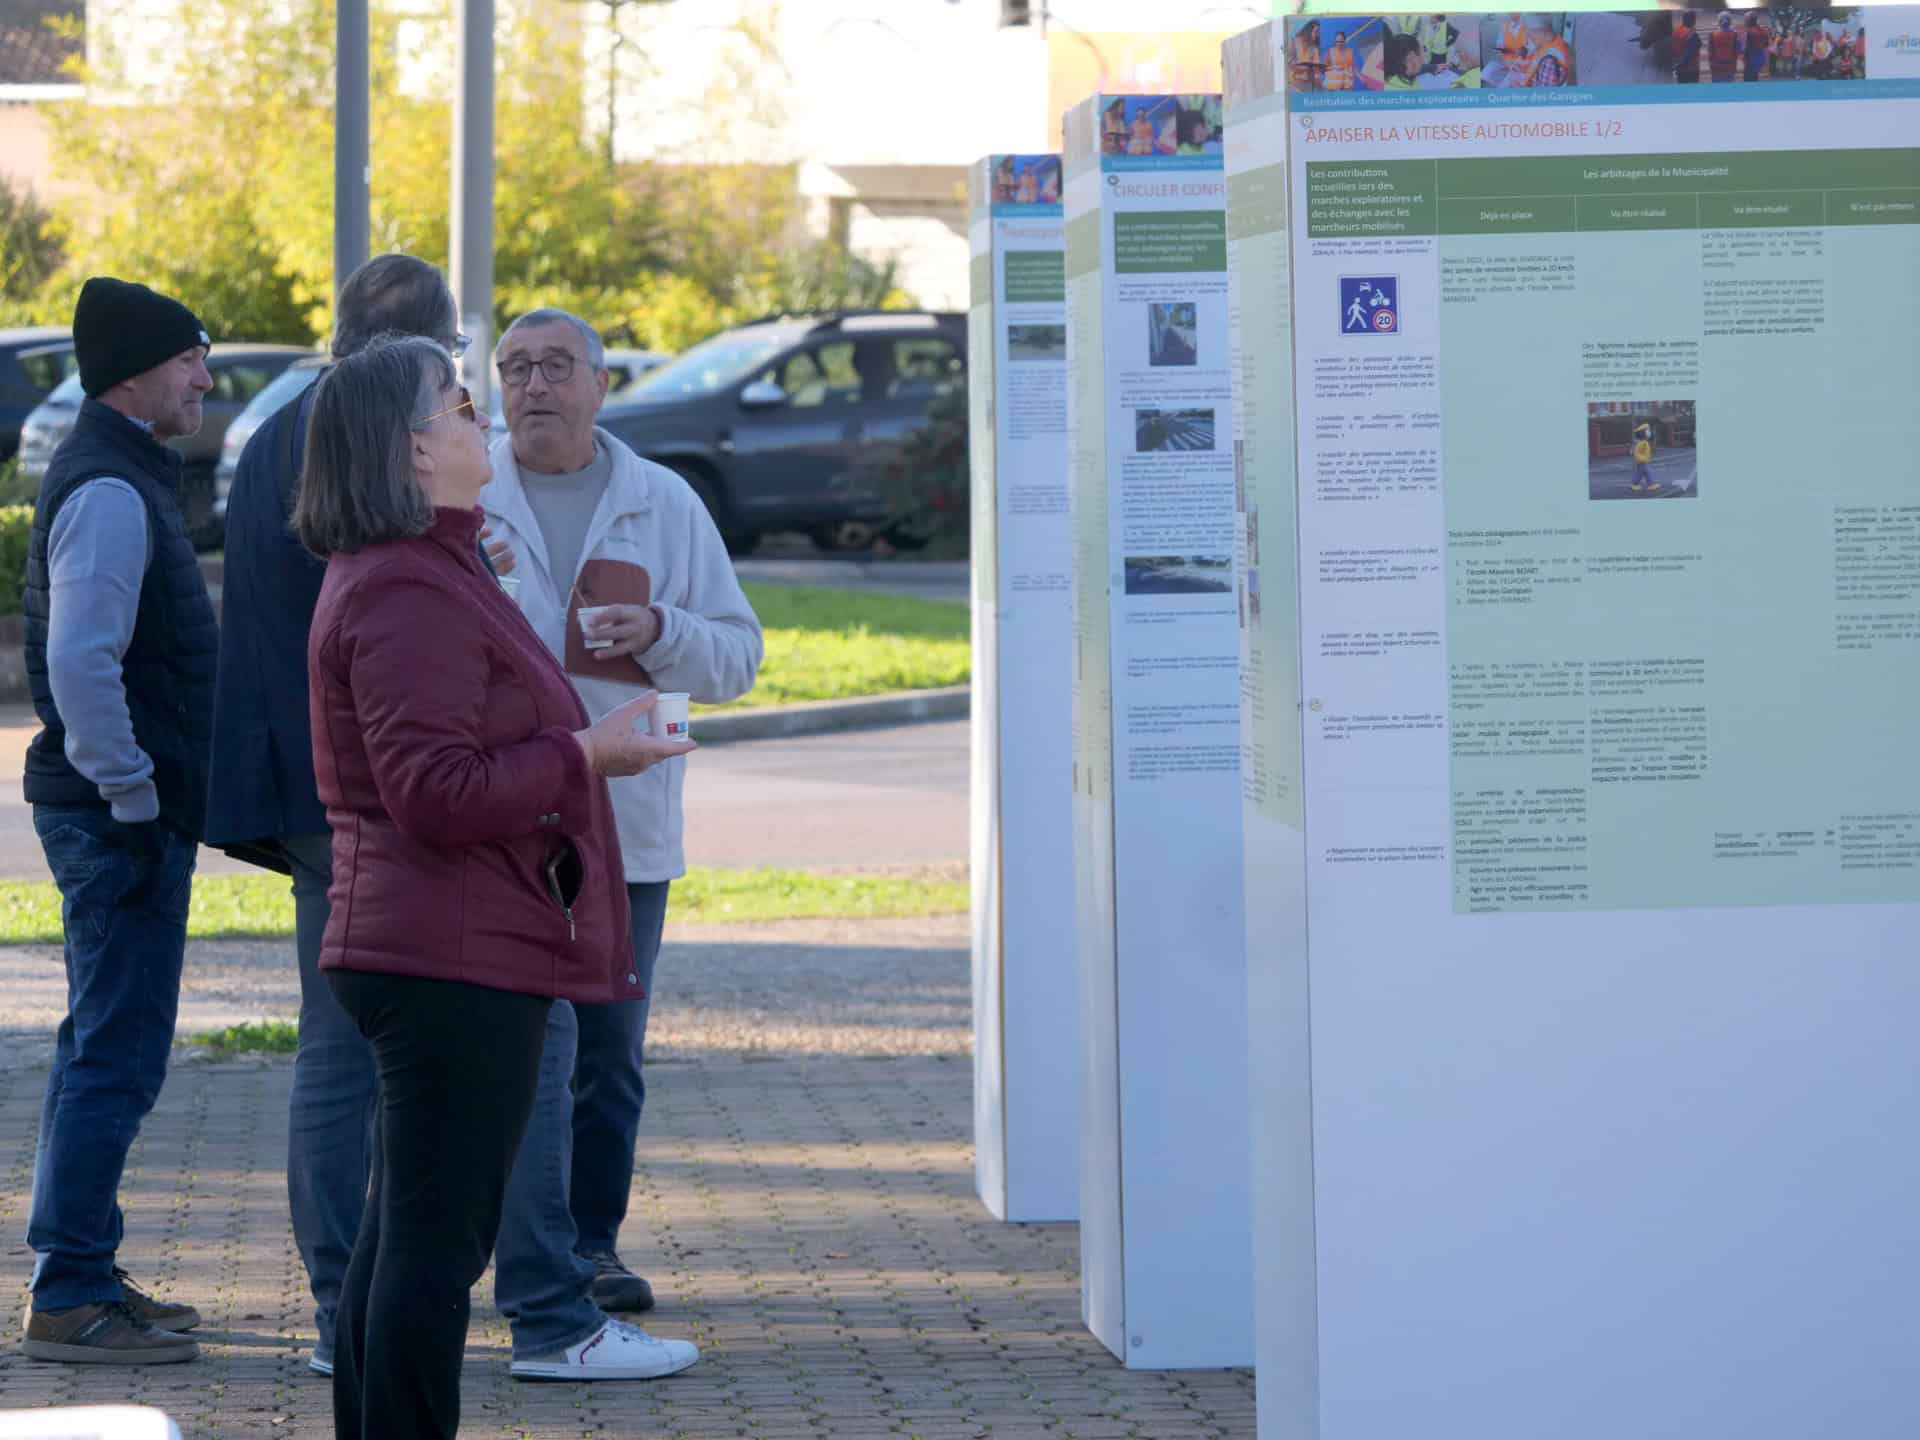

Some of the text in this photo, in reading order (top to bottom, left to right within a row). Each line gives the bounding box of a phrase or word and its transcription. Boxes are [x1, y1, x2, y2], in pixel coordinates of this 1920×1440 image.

[1358, 95, 1375, 105] des
[1376, 95, 1415, 105] marches
[1488, 93, 1527, 105] Quartier
[1305, 120, 1624, 143] APAISER LA VITESSE AUTOMOBILE 1/2
[1311, 168, 1388, 178] Les contributions
[1583, 168, 1599, 179] Les
[1600, 167, 1647, 181] arbitrages
[1648, 167, 1660, 177] de
[1662, 167, 1671, 177] la
[1113, 182, 1179, 198] CIRCULER
[1311, 182, 1356, 192] recueillies
[1377, 181, 1394, 190] des
[1311, 195, 1349, 205] marches
[1413, 193, 1423, 203] et
[1311, 208, 1327, 218] des
[1374, 209, 1395, 217] avec
[1397, 206, 1411, 217] les
[1311, 222, 1360, 232] marcheurs
[1378, 316, 1391, 325] 20
